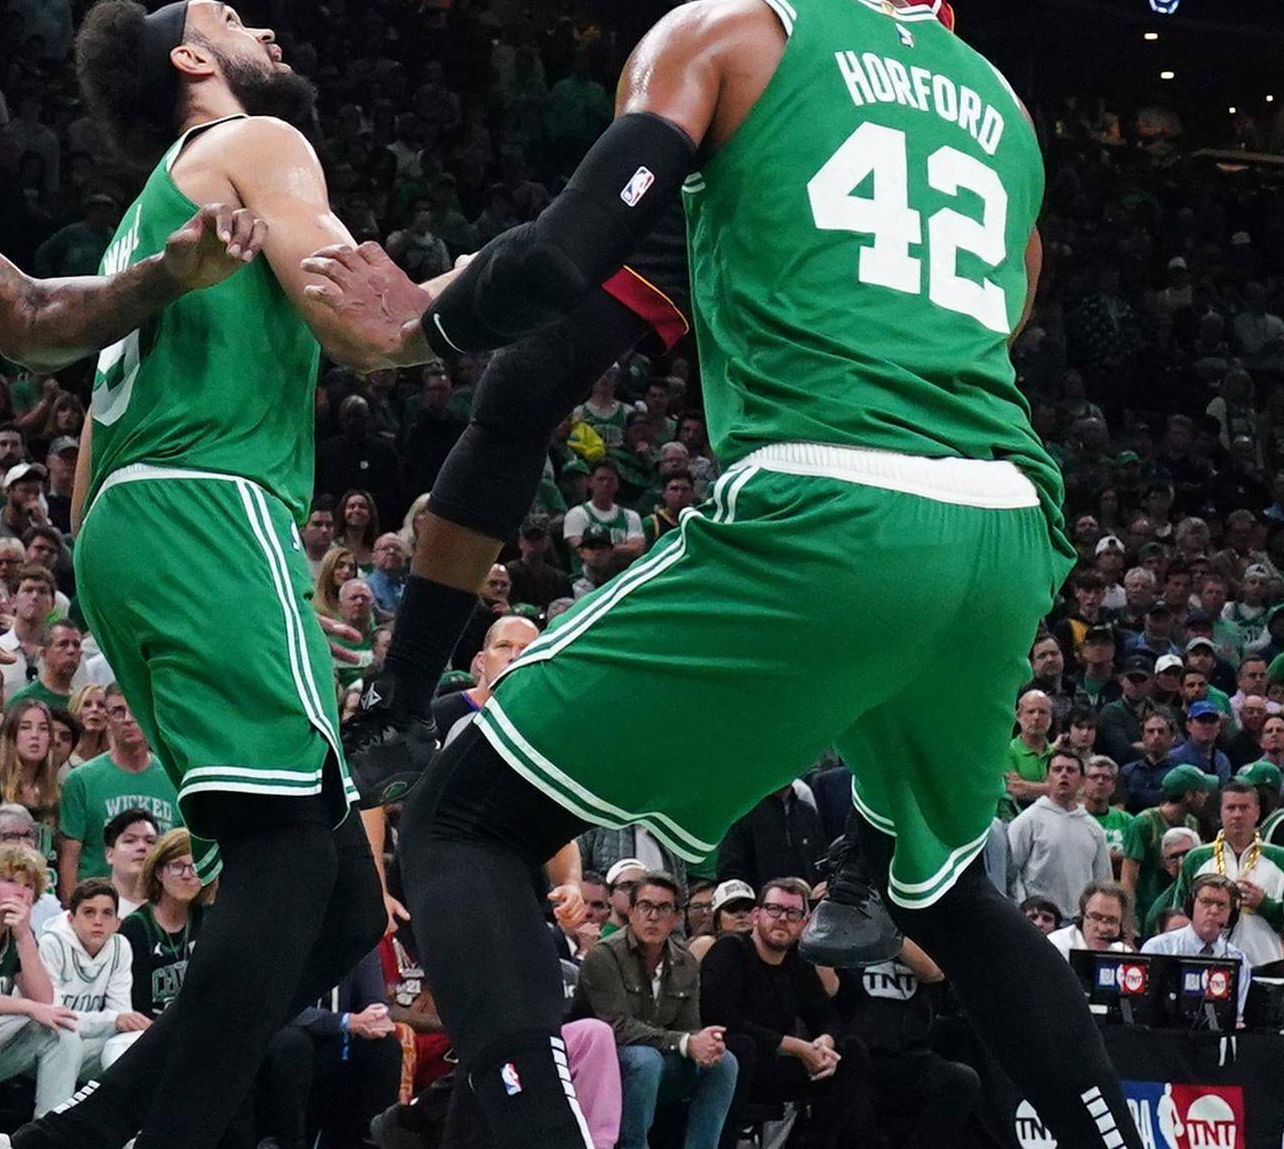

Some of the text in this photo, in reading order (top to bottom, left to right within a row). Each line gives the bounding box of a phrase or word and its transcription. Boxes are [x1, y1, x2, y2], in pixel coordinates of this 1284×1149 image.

[834, 50, 1005, 156] HORFORD
[807, 121, 1012, 335] 42
[865, 971, 916, 991] TNT
[1186, 1120, 1236, 1147] TNT
